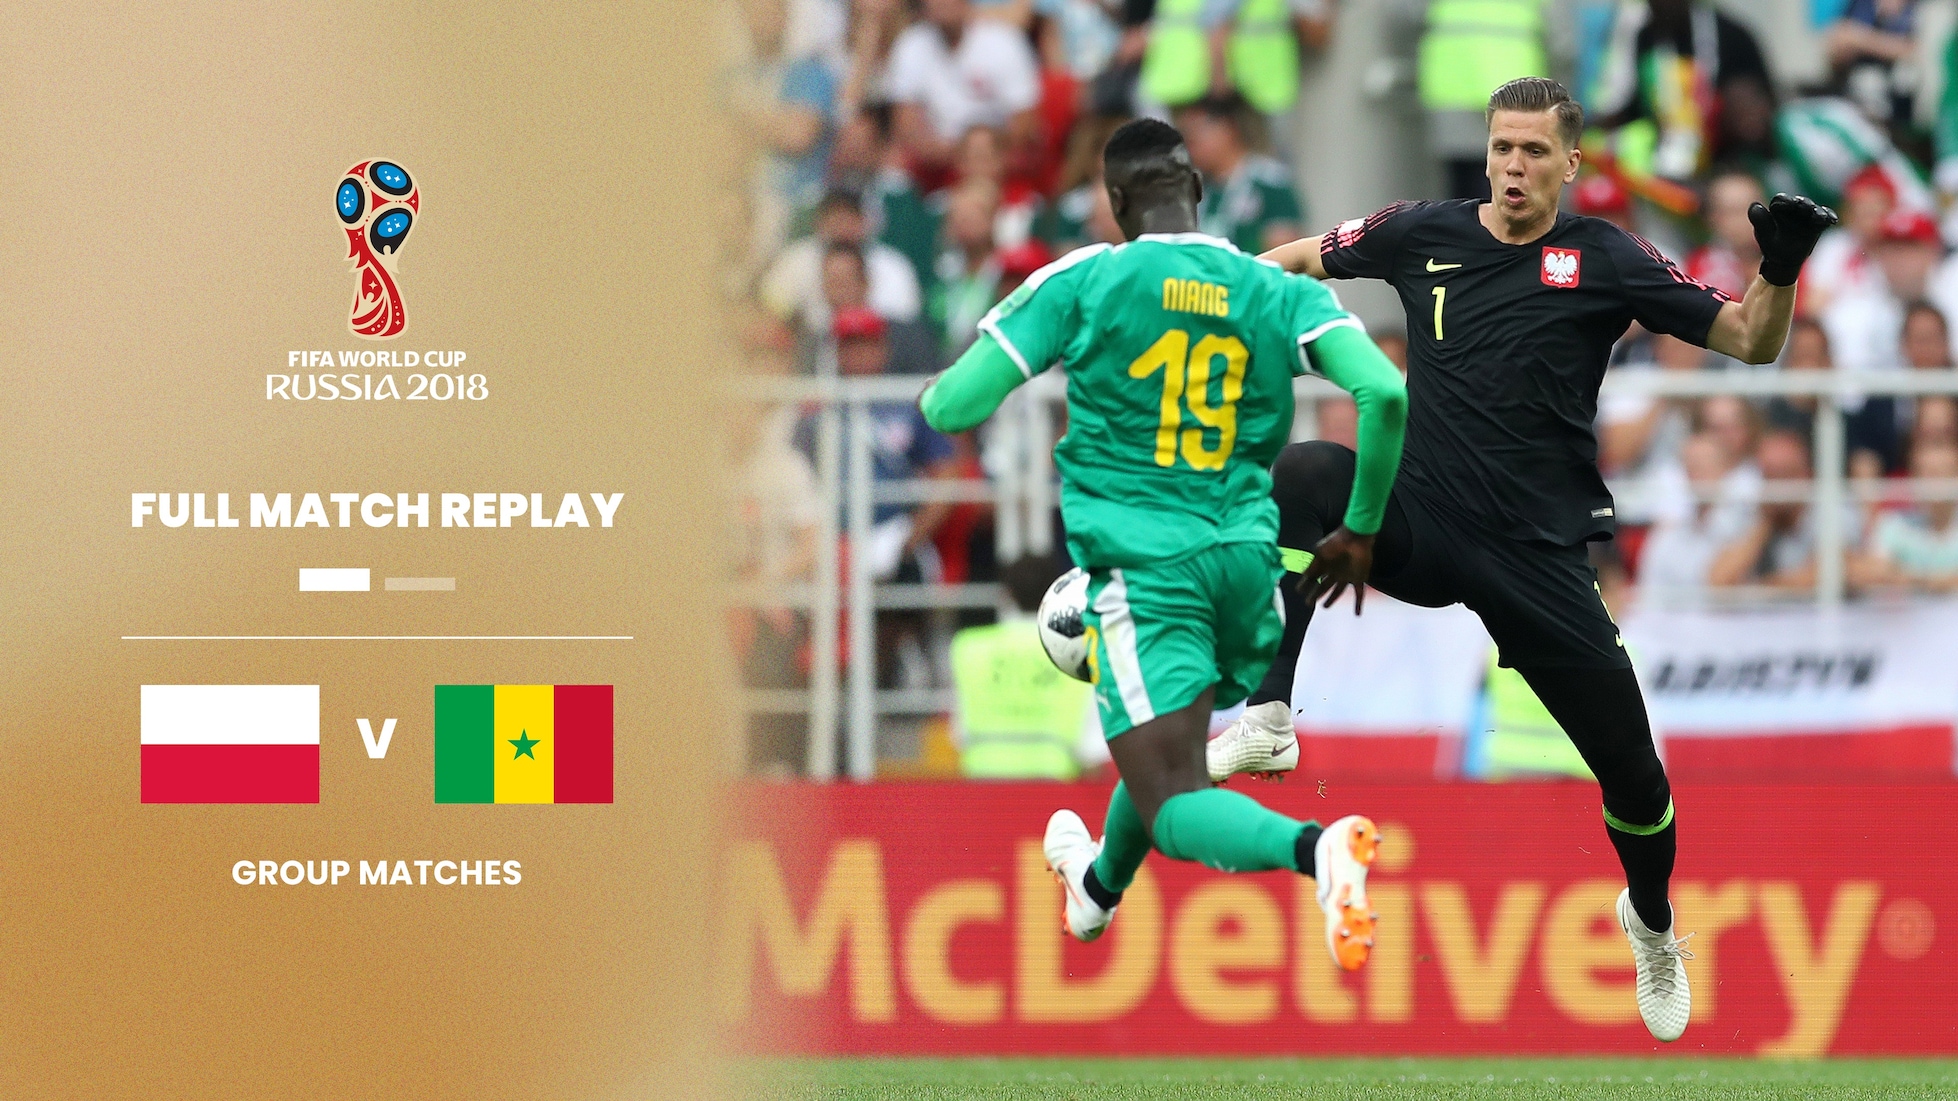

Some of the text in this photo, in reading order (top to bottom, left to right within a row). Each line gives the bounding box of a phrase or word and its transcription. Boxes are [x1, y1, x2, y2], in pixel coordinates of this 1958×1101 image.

[1163, 277, 1229, 317] NIANG
[1432, 286, 1446, 341] 1
[1128, 328, 1250, 471] 19
